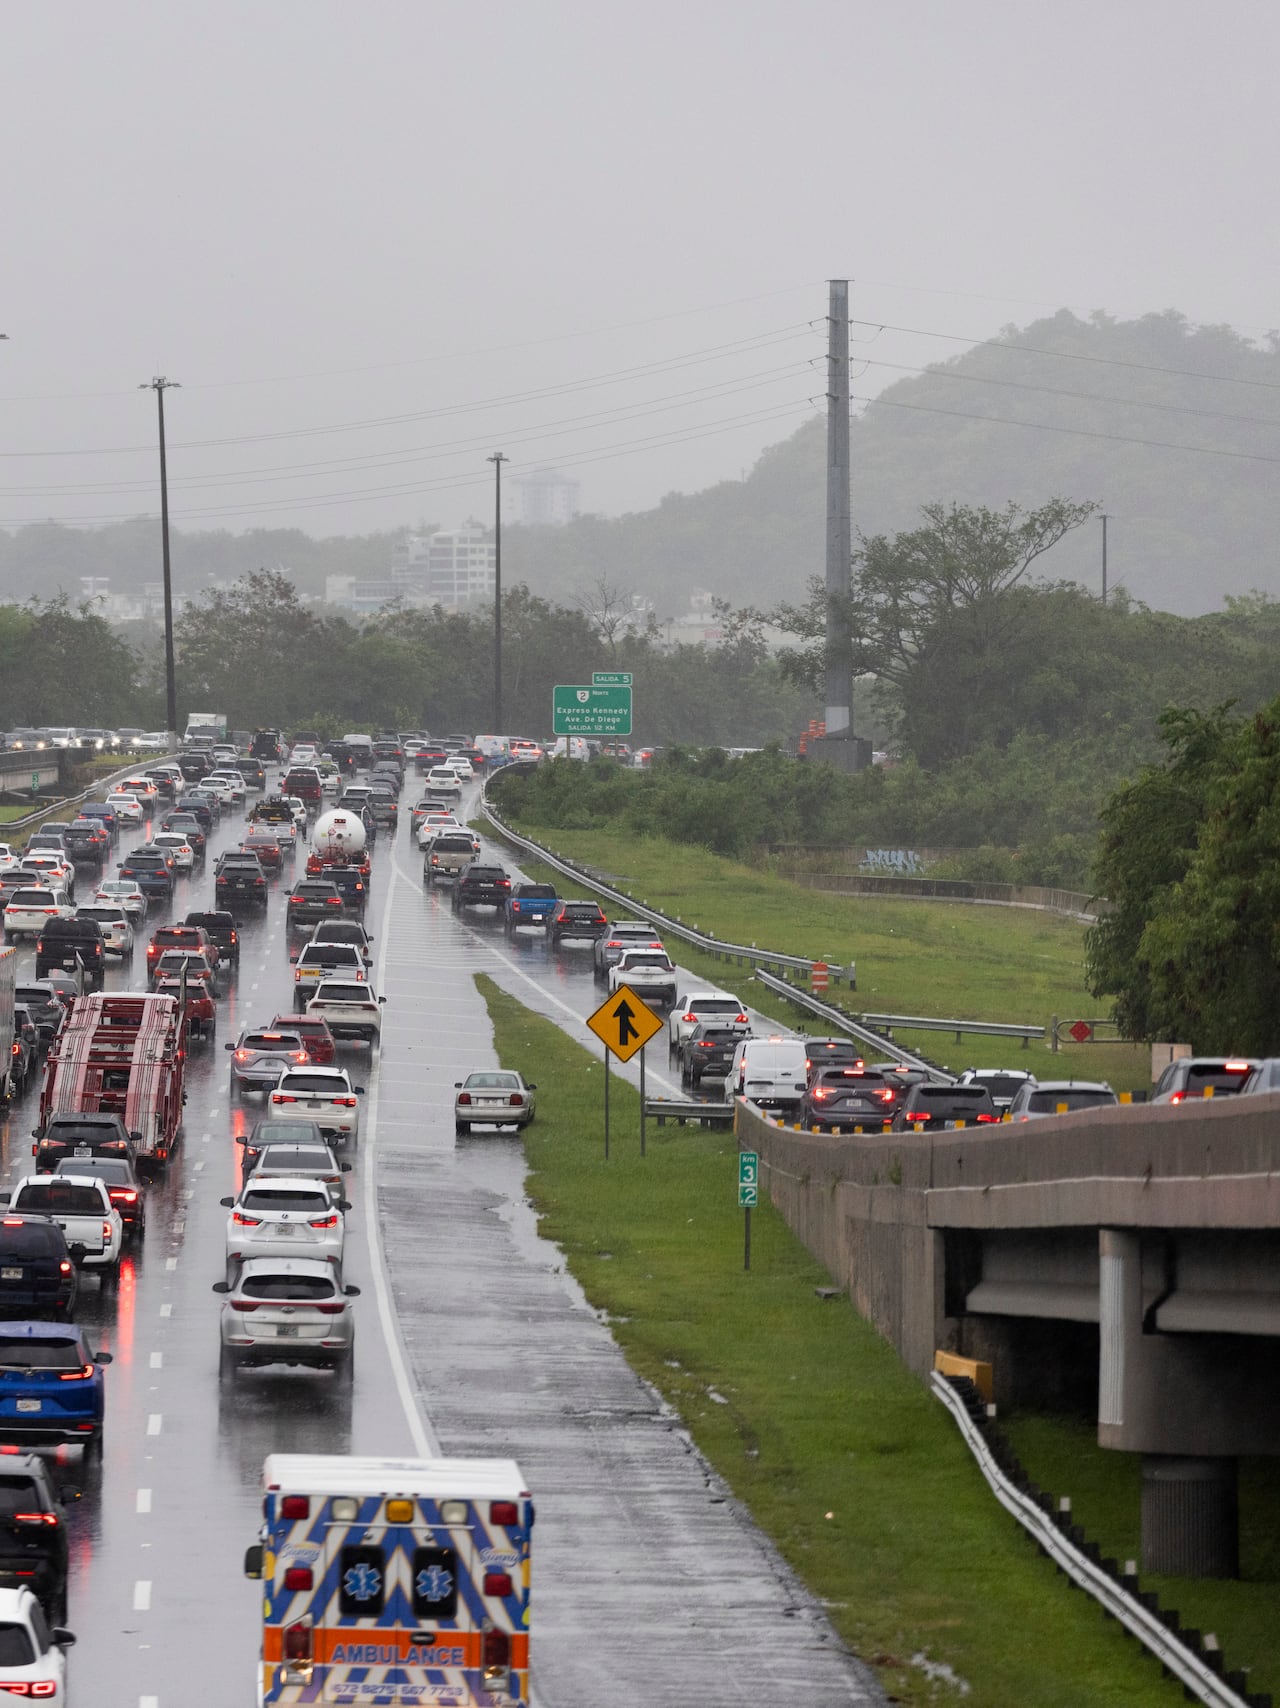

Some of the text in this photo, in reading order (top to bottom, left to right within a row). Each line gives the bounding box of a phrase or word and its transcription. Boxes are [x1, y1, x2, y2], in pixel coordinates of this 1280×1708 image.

[623, 675, 630, 683] 5
[580, 692, 586, 701] 2
[557, 707, 628, 715] Expreso Kennedy
[598, 716, 621, 724] Diego
[743, 1165, 753, 1182] 3
[331, 1644, 465, 1667] AMBULANCE
[334, 1684, 358, 1693] 672
